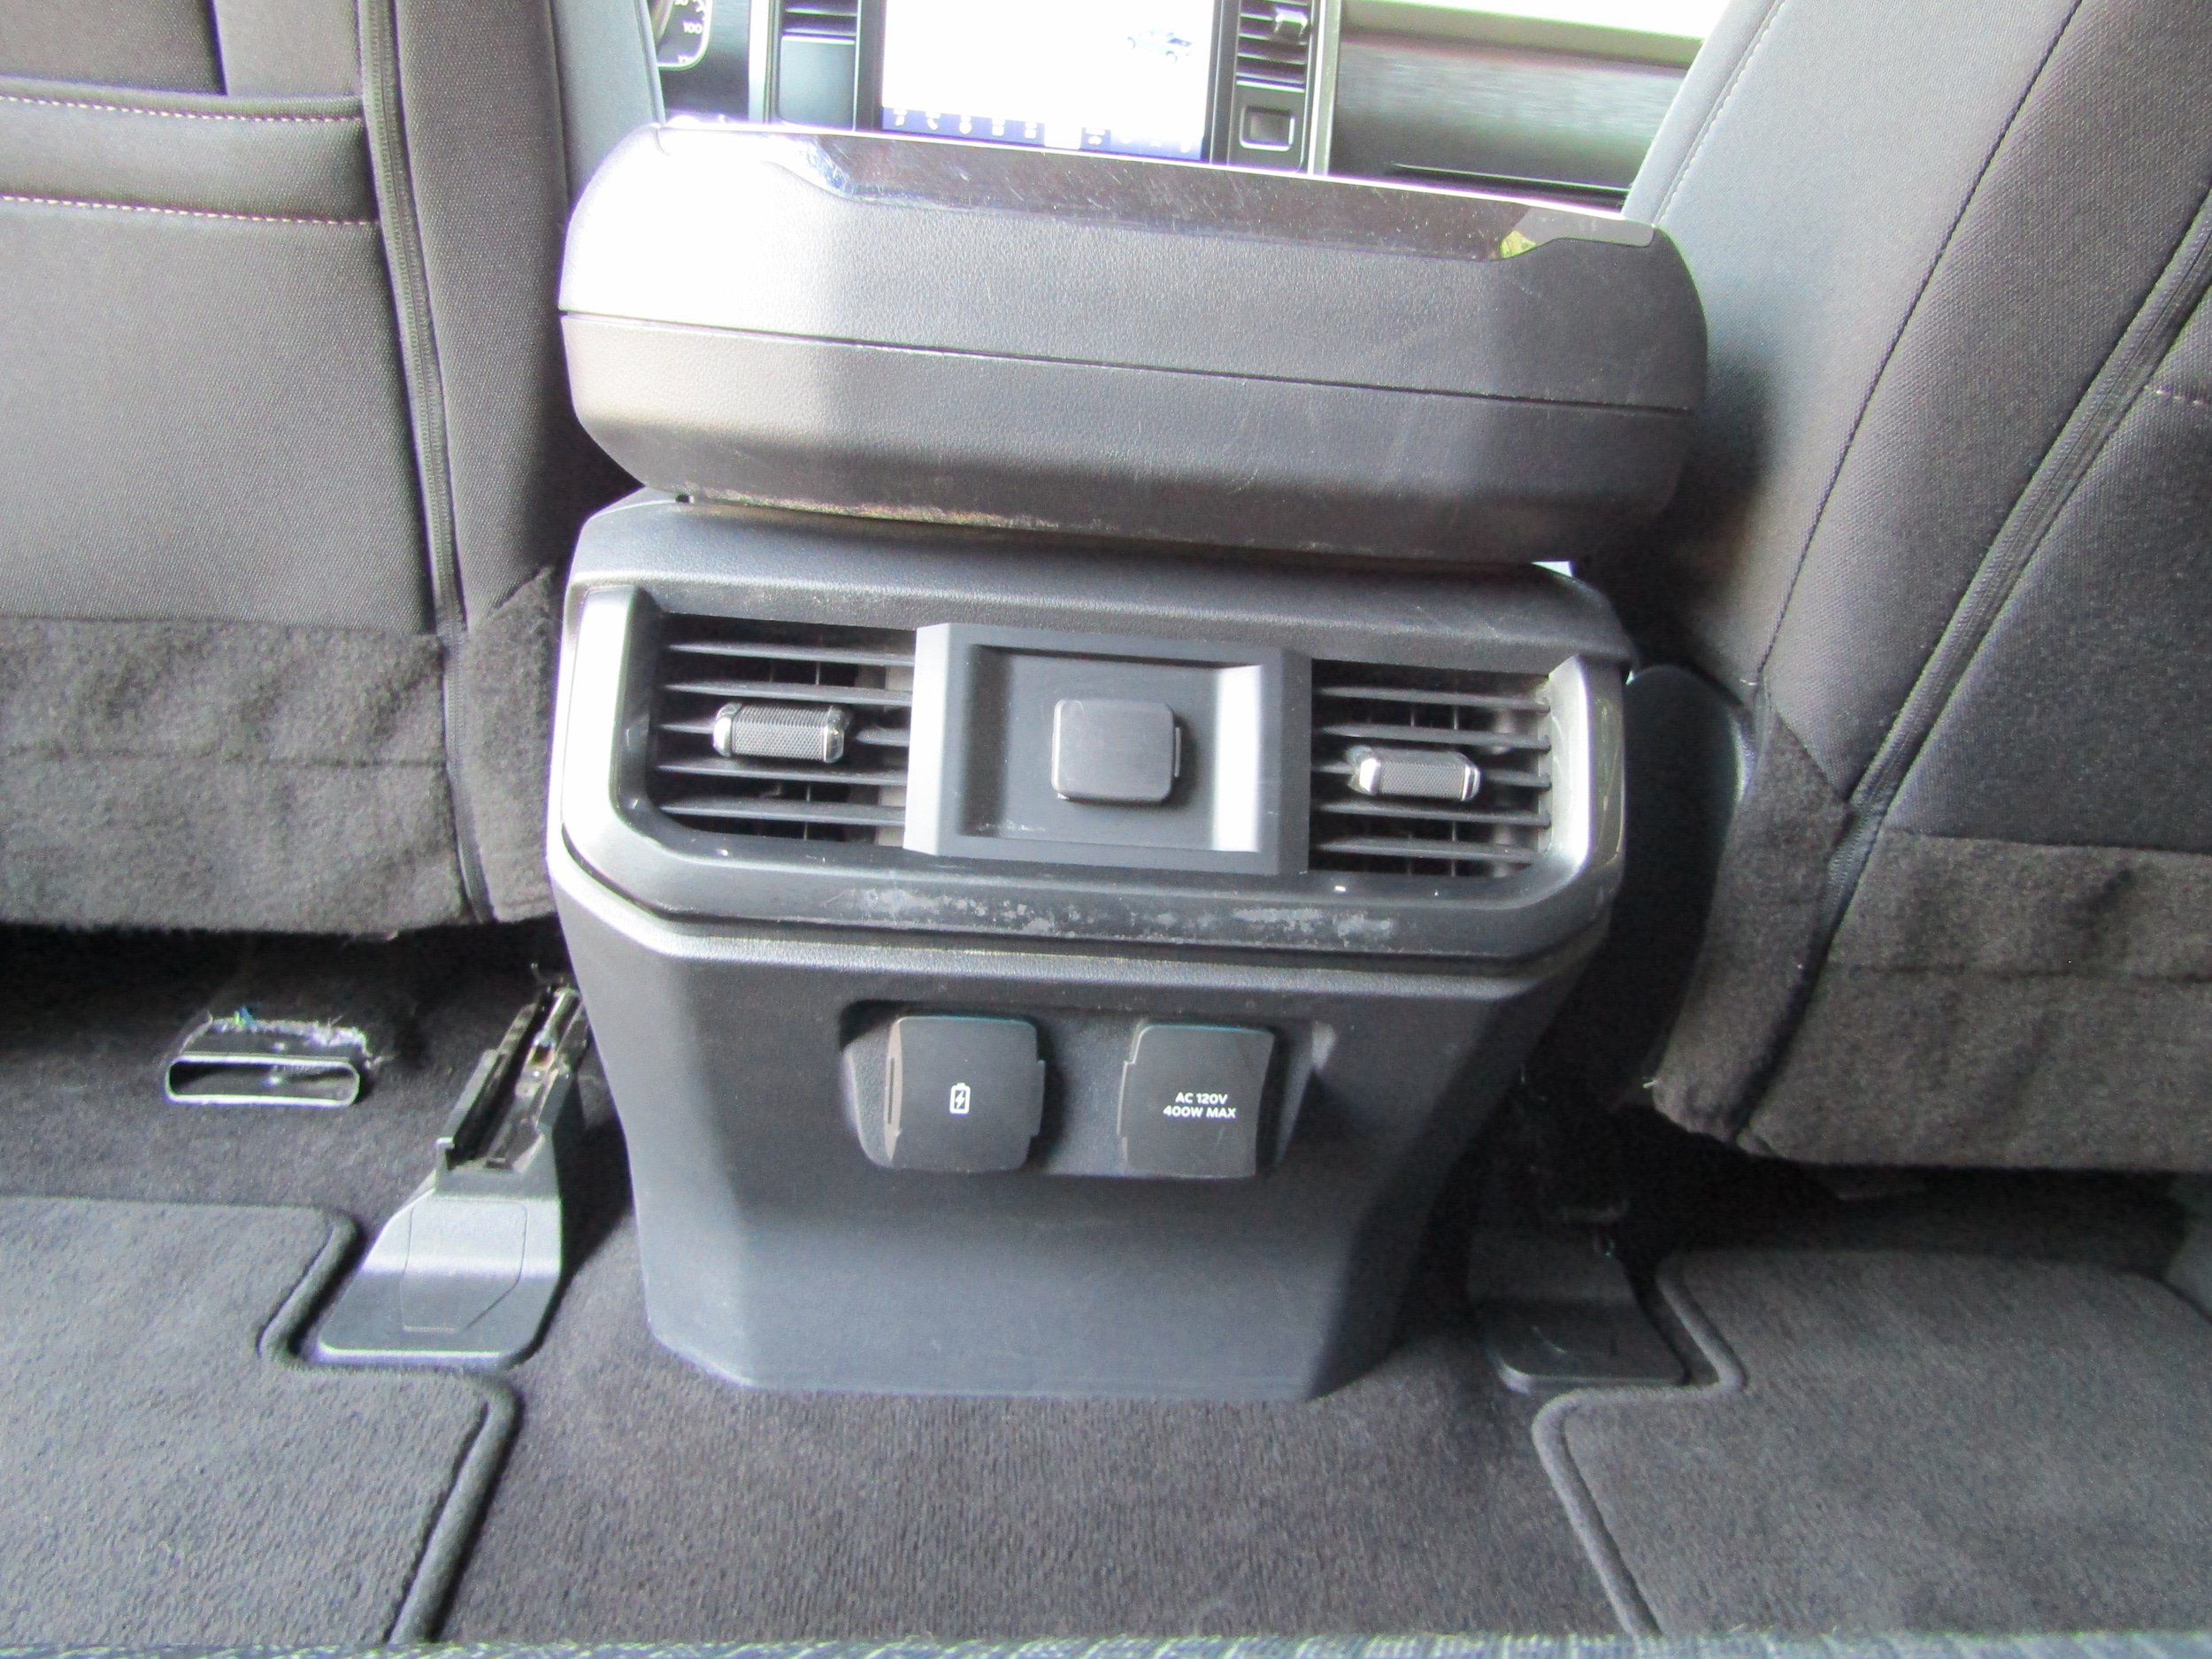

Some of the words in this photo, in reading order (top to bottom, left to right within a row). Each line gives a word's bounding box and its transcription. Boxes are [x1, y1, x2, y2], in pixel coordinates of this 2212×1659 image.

[683, 21, 702, 34] 100
[1175, 1092, 1194, 1103] AC
[1196, 1093, 1228, 1104] 120V
[1163, 1105, 1203, 1118] 400W
[1206, 1107, 1236, 1118] MAX
